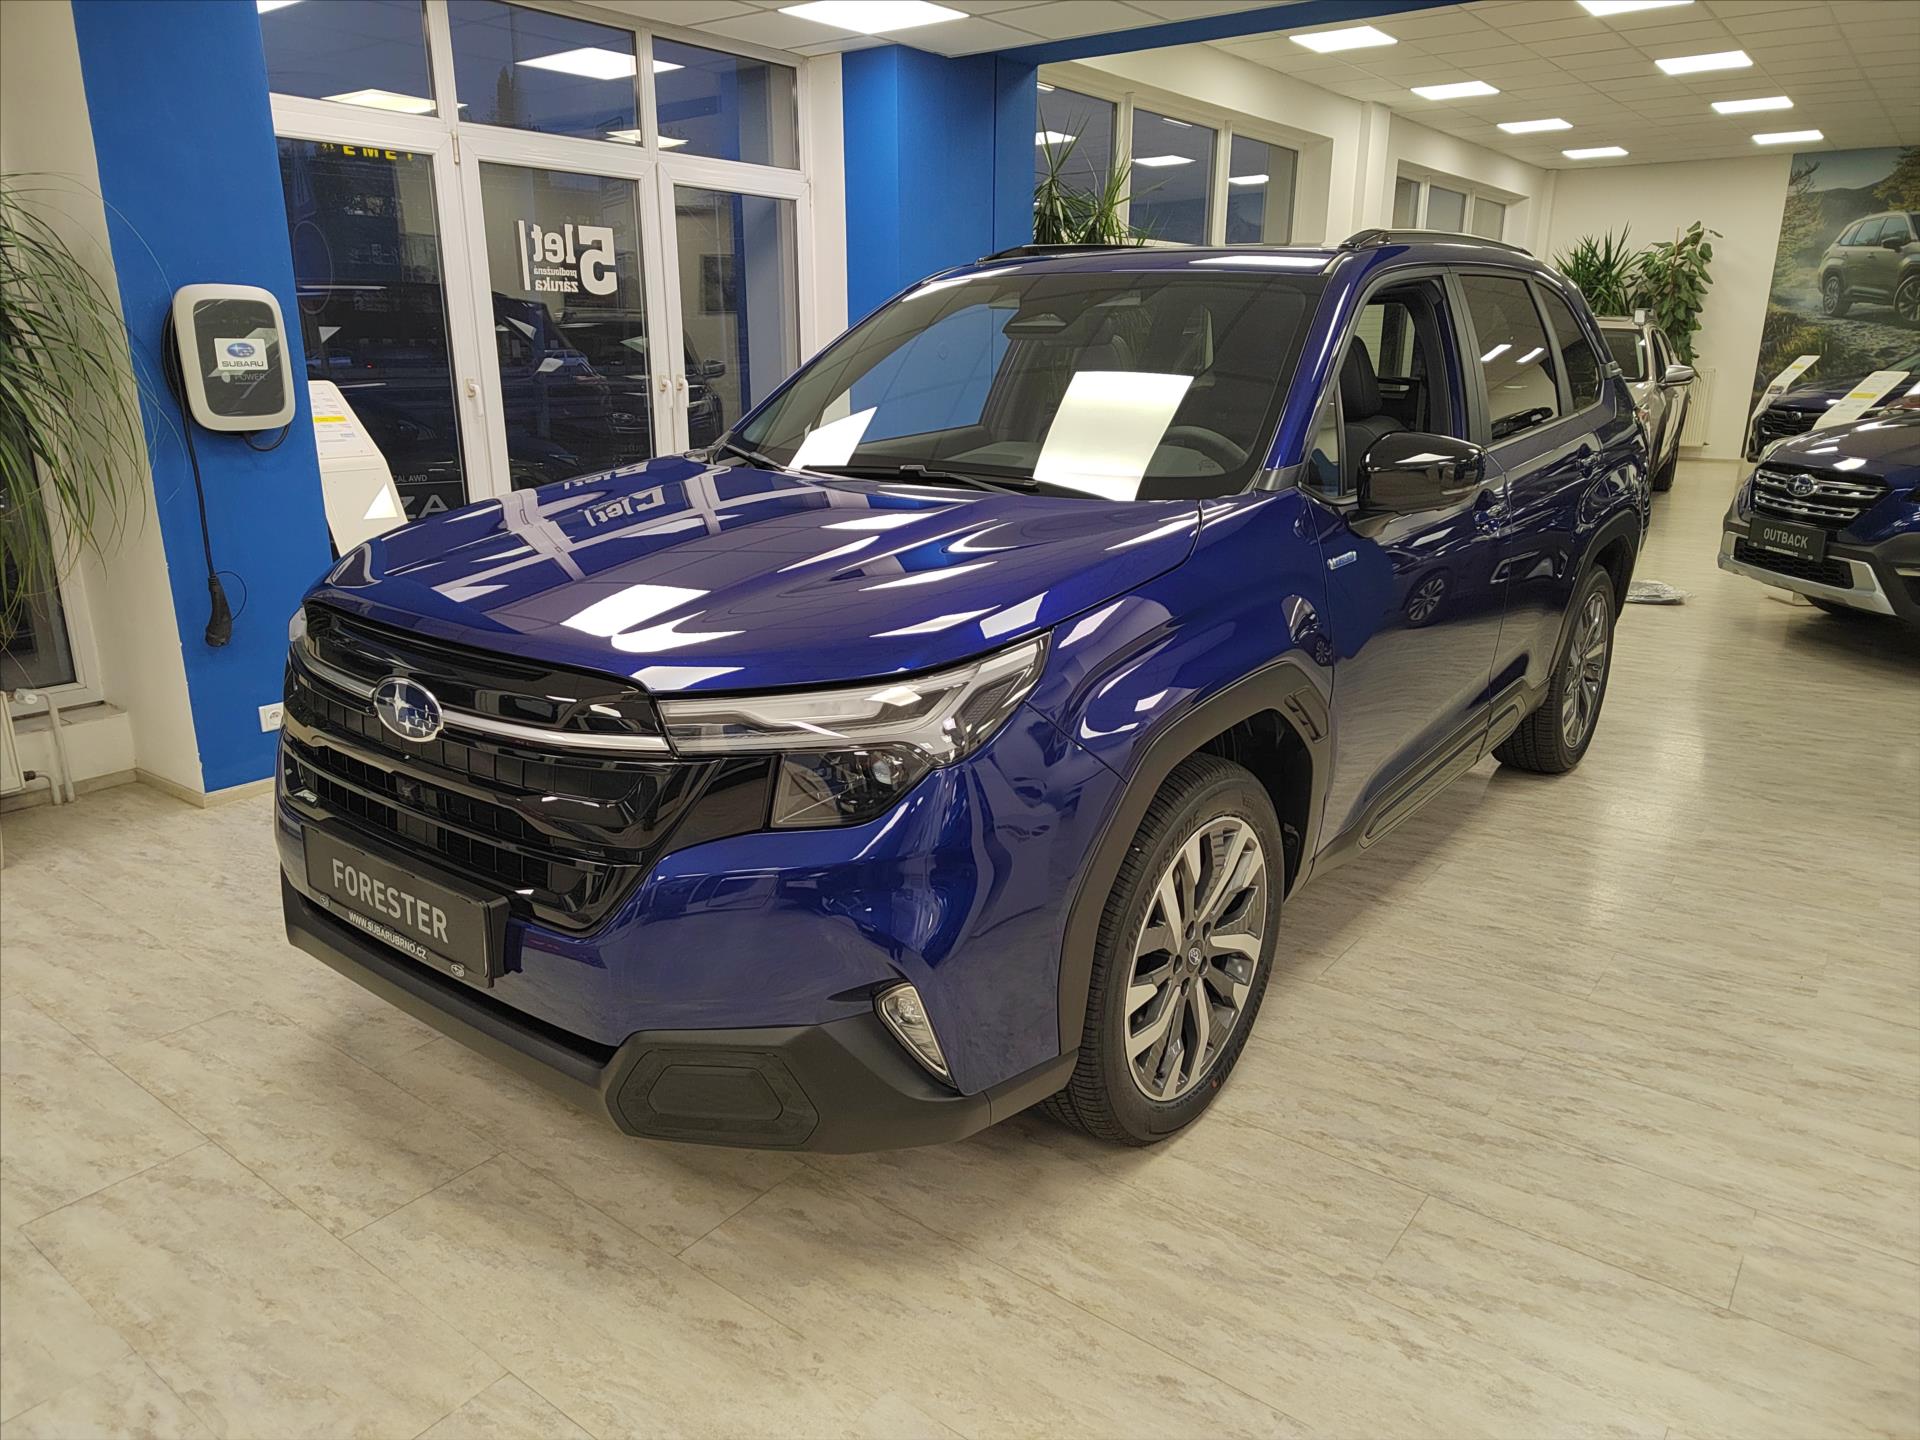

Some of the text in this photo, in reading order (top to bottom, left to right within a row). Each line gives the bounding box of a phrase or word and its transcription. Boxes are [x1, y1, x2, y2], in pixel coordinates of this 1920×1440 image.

[221, 360, 265, 368] SUBARU
[408, 474, 428, 482] AWD
[1763, 527, 1809, 549] OUTBACK
[332, 858, 449, 944] FORESTER
[348, 911, 428, 960] WWW.SUBARUBRNO.CZ
